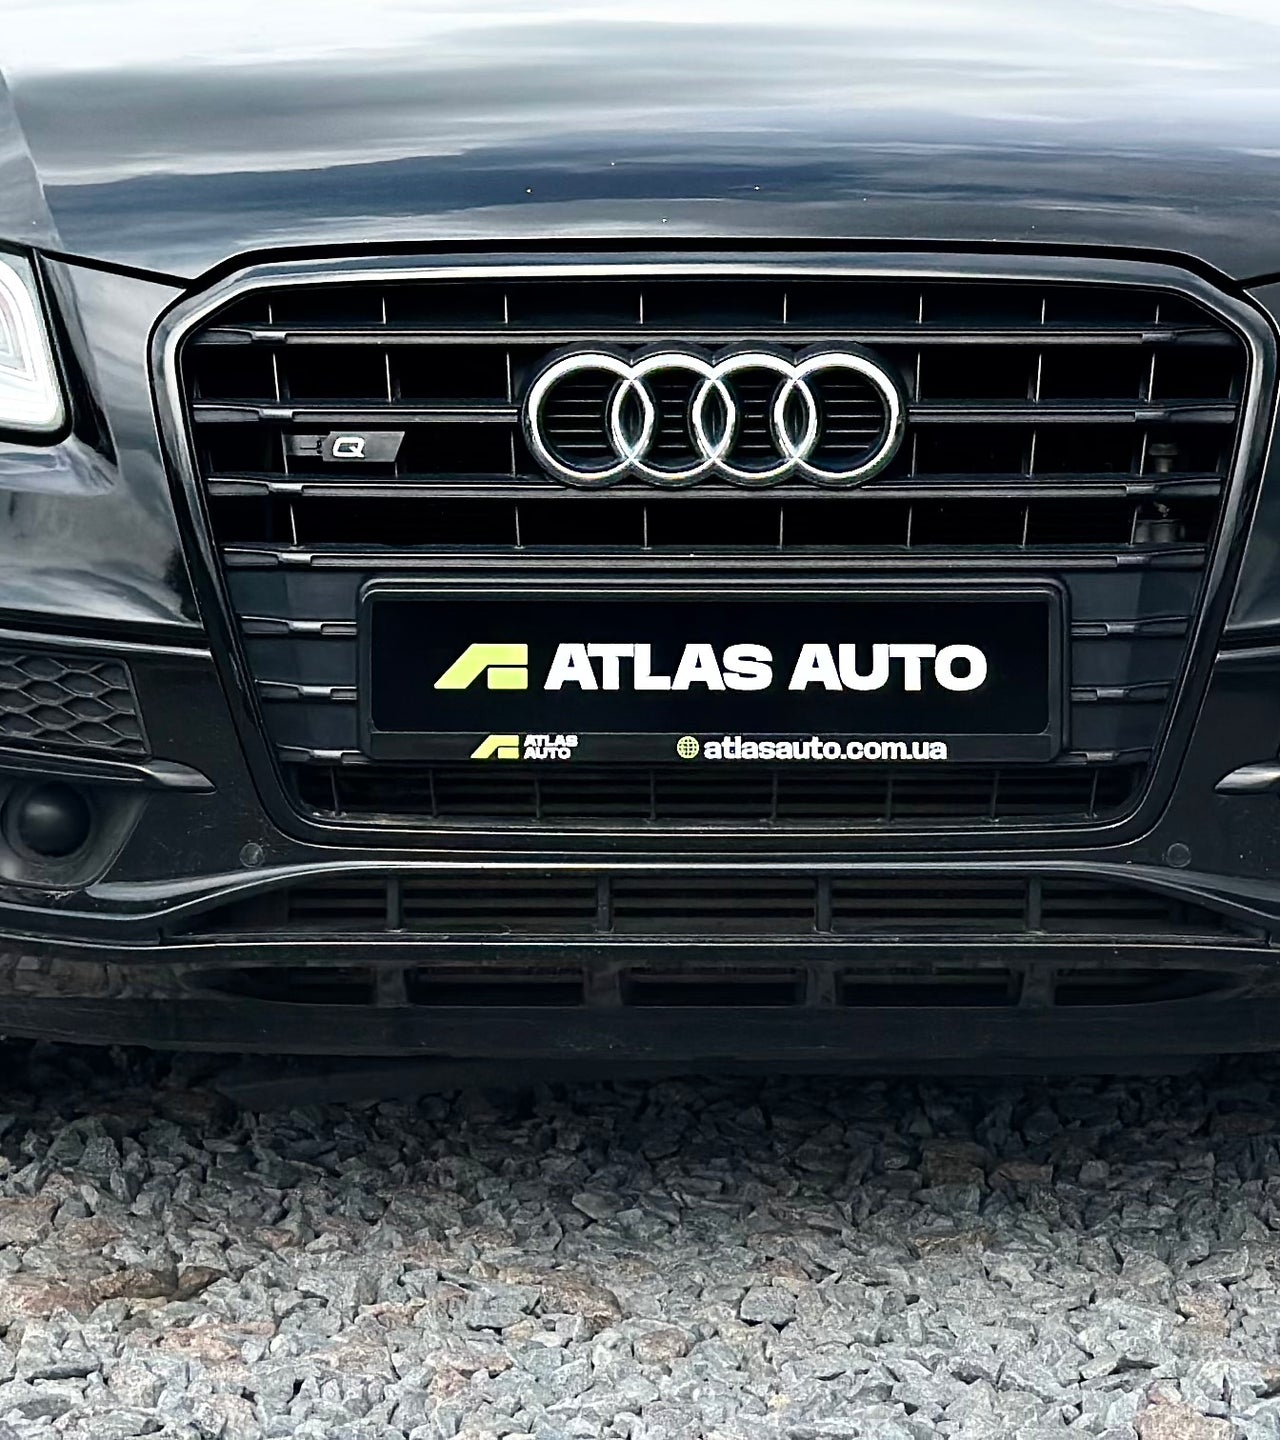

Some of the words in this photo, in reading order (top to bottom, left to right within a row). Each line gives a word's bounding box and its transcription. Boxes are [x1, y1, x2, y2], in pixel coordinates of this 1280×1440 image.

[543, 642, 773, 691] ATLAS
[788, 642, 988, 692] AUTO
[523, 734, 579, 747] ATLAS
[703, 735, 949, 760] atlasauto.com.ua
[523, 747, 572, 760] AUTO
